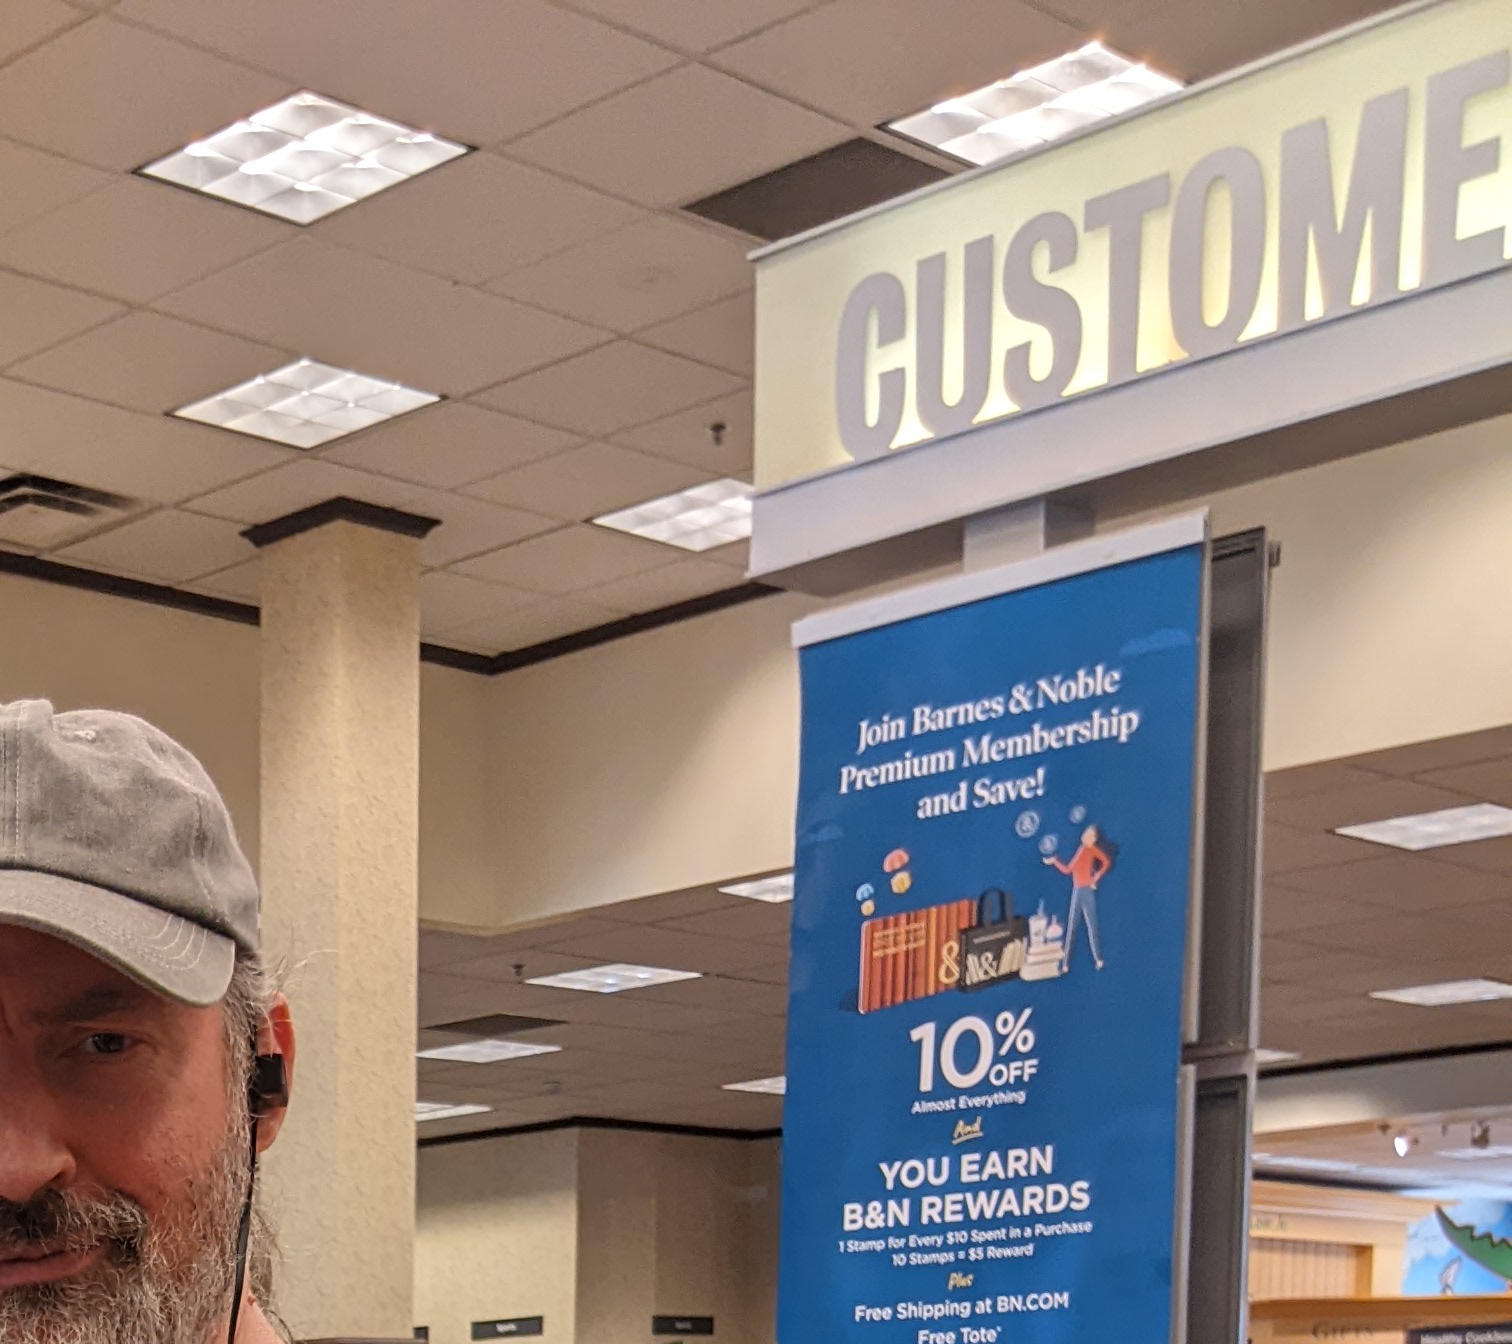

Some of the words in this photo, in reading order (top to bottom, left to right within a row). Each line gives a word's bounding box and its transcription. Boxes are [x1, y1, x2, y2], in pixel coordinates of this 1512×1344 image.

[835, 50, 1512, 461] CUSTOME
[856, 719, 906, 755] Join
[912, 696, 1004, 737] Barnes
[1007, 683, 1034, 715] &
[1036, 662, 1122, 709] Noble
[839, 748, 956, 795] Premium
[962, 706, 1140, 768] Membership
[916, 781, 967, 819] and
[972, 767, 1046, 809] Save!
[909, 1007, 1036, 1093] 10%
[989, 1059, 1038, 1087] OFF
[911, 1098, 956, 1115] Almost
[958, 1089, 1027, 1113] Everything
[952, 1116, 984, 1142] And
[879, 1155, 949, 1190] YOU
[959, 1145, 1053, 1183] EARN
[842, 1199, 910, 1231] B&N
[920, 1181, 1090, 1225] REWARDS
[846, 1237, 886, 1253] Stamp
[888, 1235, 906, 1249] for
[908, 1233, 944, 1249] Every
[946, 1230, 968, 1245] $10
[970, 1227, 1007, 1243] Spent
[1009, 1225, 1022, 1239] in
[1023, 1227, 1032, 1238] a
[1034, 1220, 1093, 1237] Purchase
[891, 1253, 906, 1267] 10
[908, 1250, 955, 1266] Stamps
[968, 1248, 984, 1262] $5
[987, 1243, 1034, 1259] Reward
[854, 1304, 892, 1322] Free
[896, 1299, 971, 1321] Shipping
[974, 1297, 992, 1315] at
[996, 1292, 1070, 1313] BN.COM
